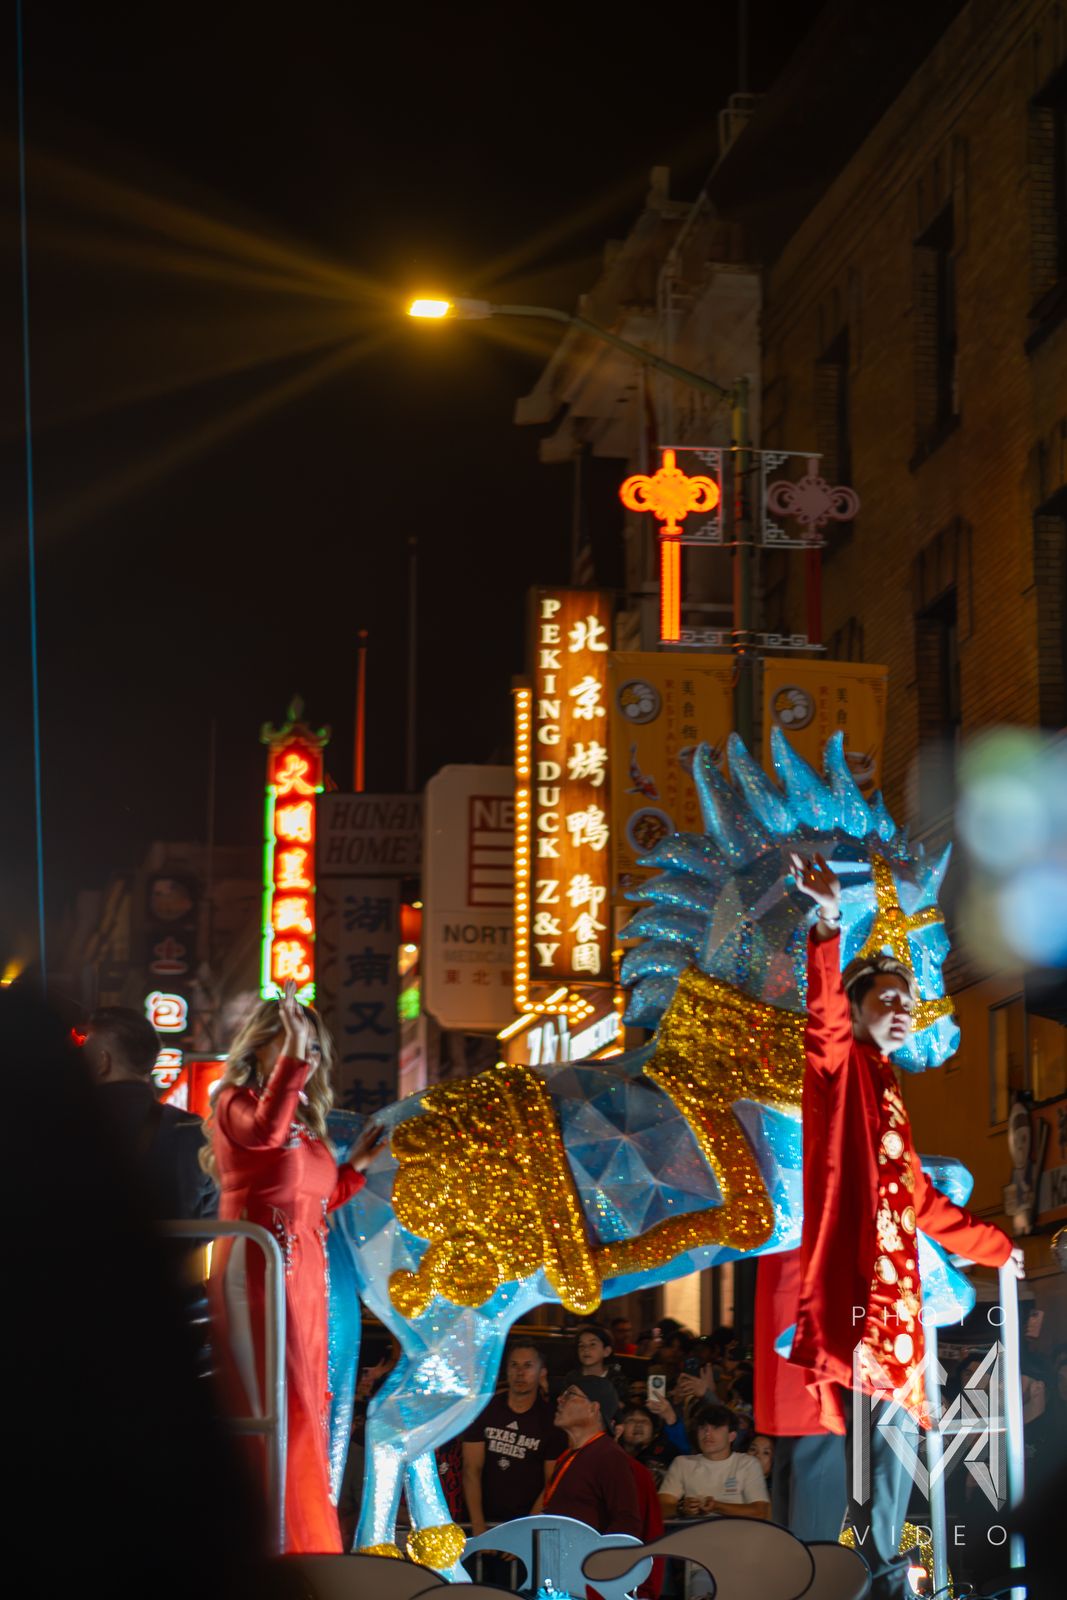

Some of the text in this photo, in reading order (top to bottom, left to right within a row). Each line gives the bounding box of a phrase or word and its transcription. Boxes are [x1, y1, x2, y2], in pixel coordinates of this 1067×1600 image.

[533, 599, 562, 967] PEKING DUCK Z&Y
[485, 1427, 517, 1444] TEXAS
[489, 1440, 526, 1459] AGGIES
